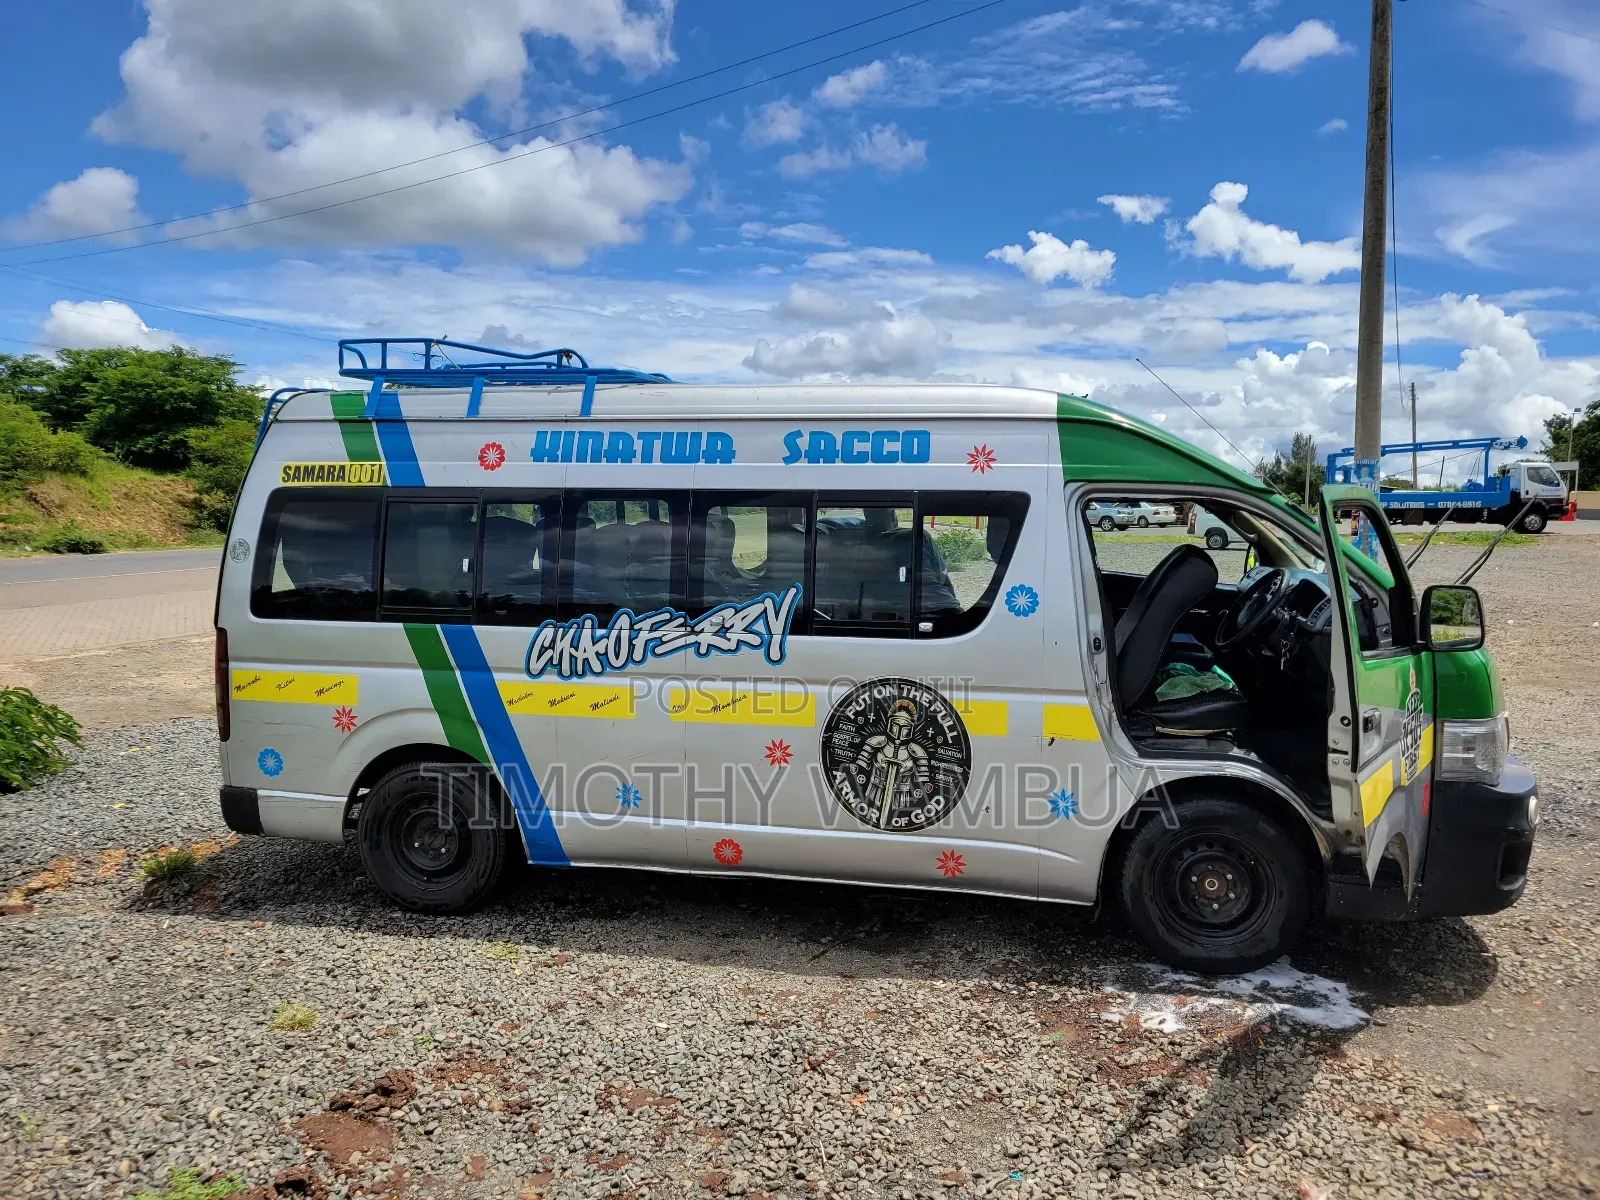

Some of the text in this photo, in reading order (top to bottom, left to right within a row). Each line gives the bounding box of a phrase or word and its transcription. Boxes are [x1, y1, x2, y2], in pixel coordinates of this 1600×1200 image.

[530, 429, 931, 465] KINATWA SACCO
[281, 464, 383, 483] SAMARA 001
[1389, 501, 1425, 509] SOLUTIONS
[233, 675, 345, 698] Nairobi Kitui Mwingi
[589, 693, 621, 711] Malindi
[844, 683, 958, 744] PUT ON THE FULL
[832, 732, 852, 742] GOSPEL
[839, 723, 856, 733] FAITH
[831, 737, 850, 747] PEACE
[834, 748, 854, 758] TRUTH
[833, 770, 946, 827] ARMOR OF GOD
